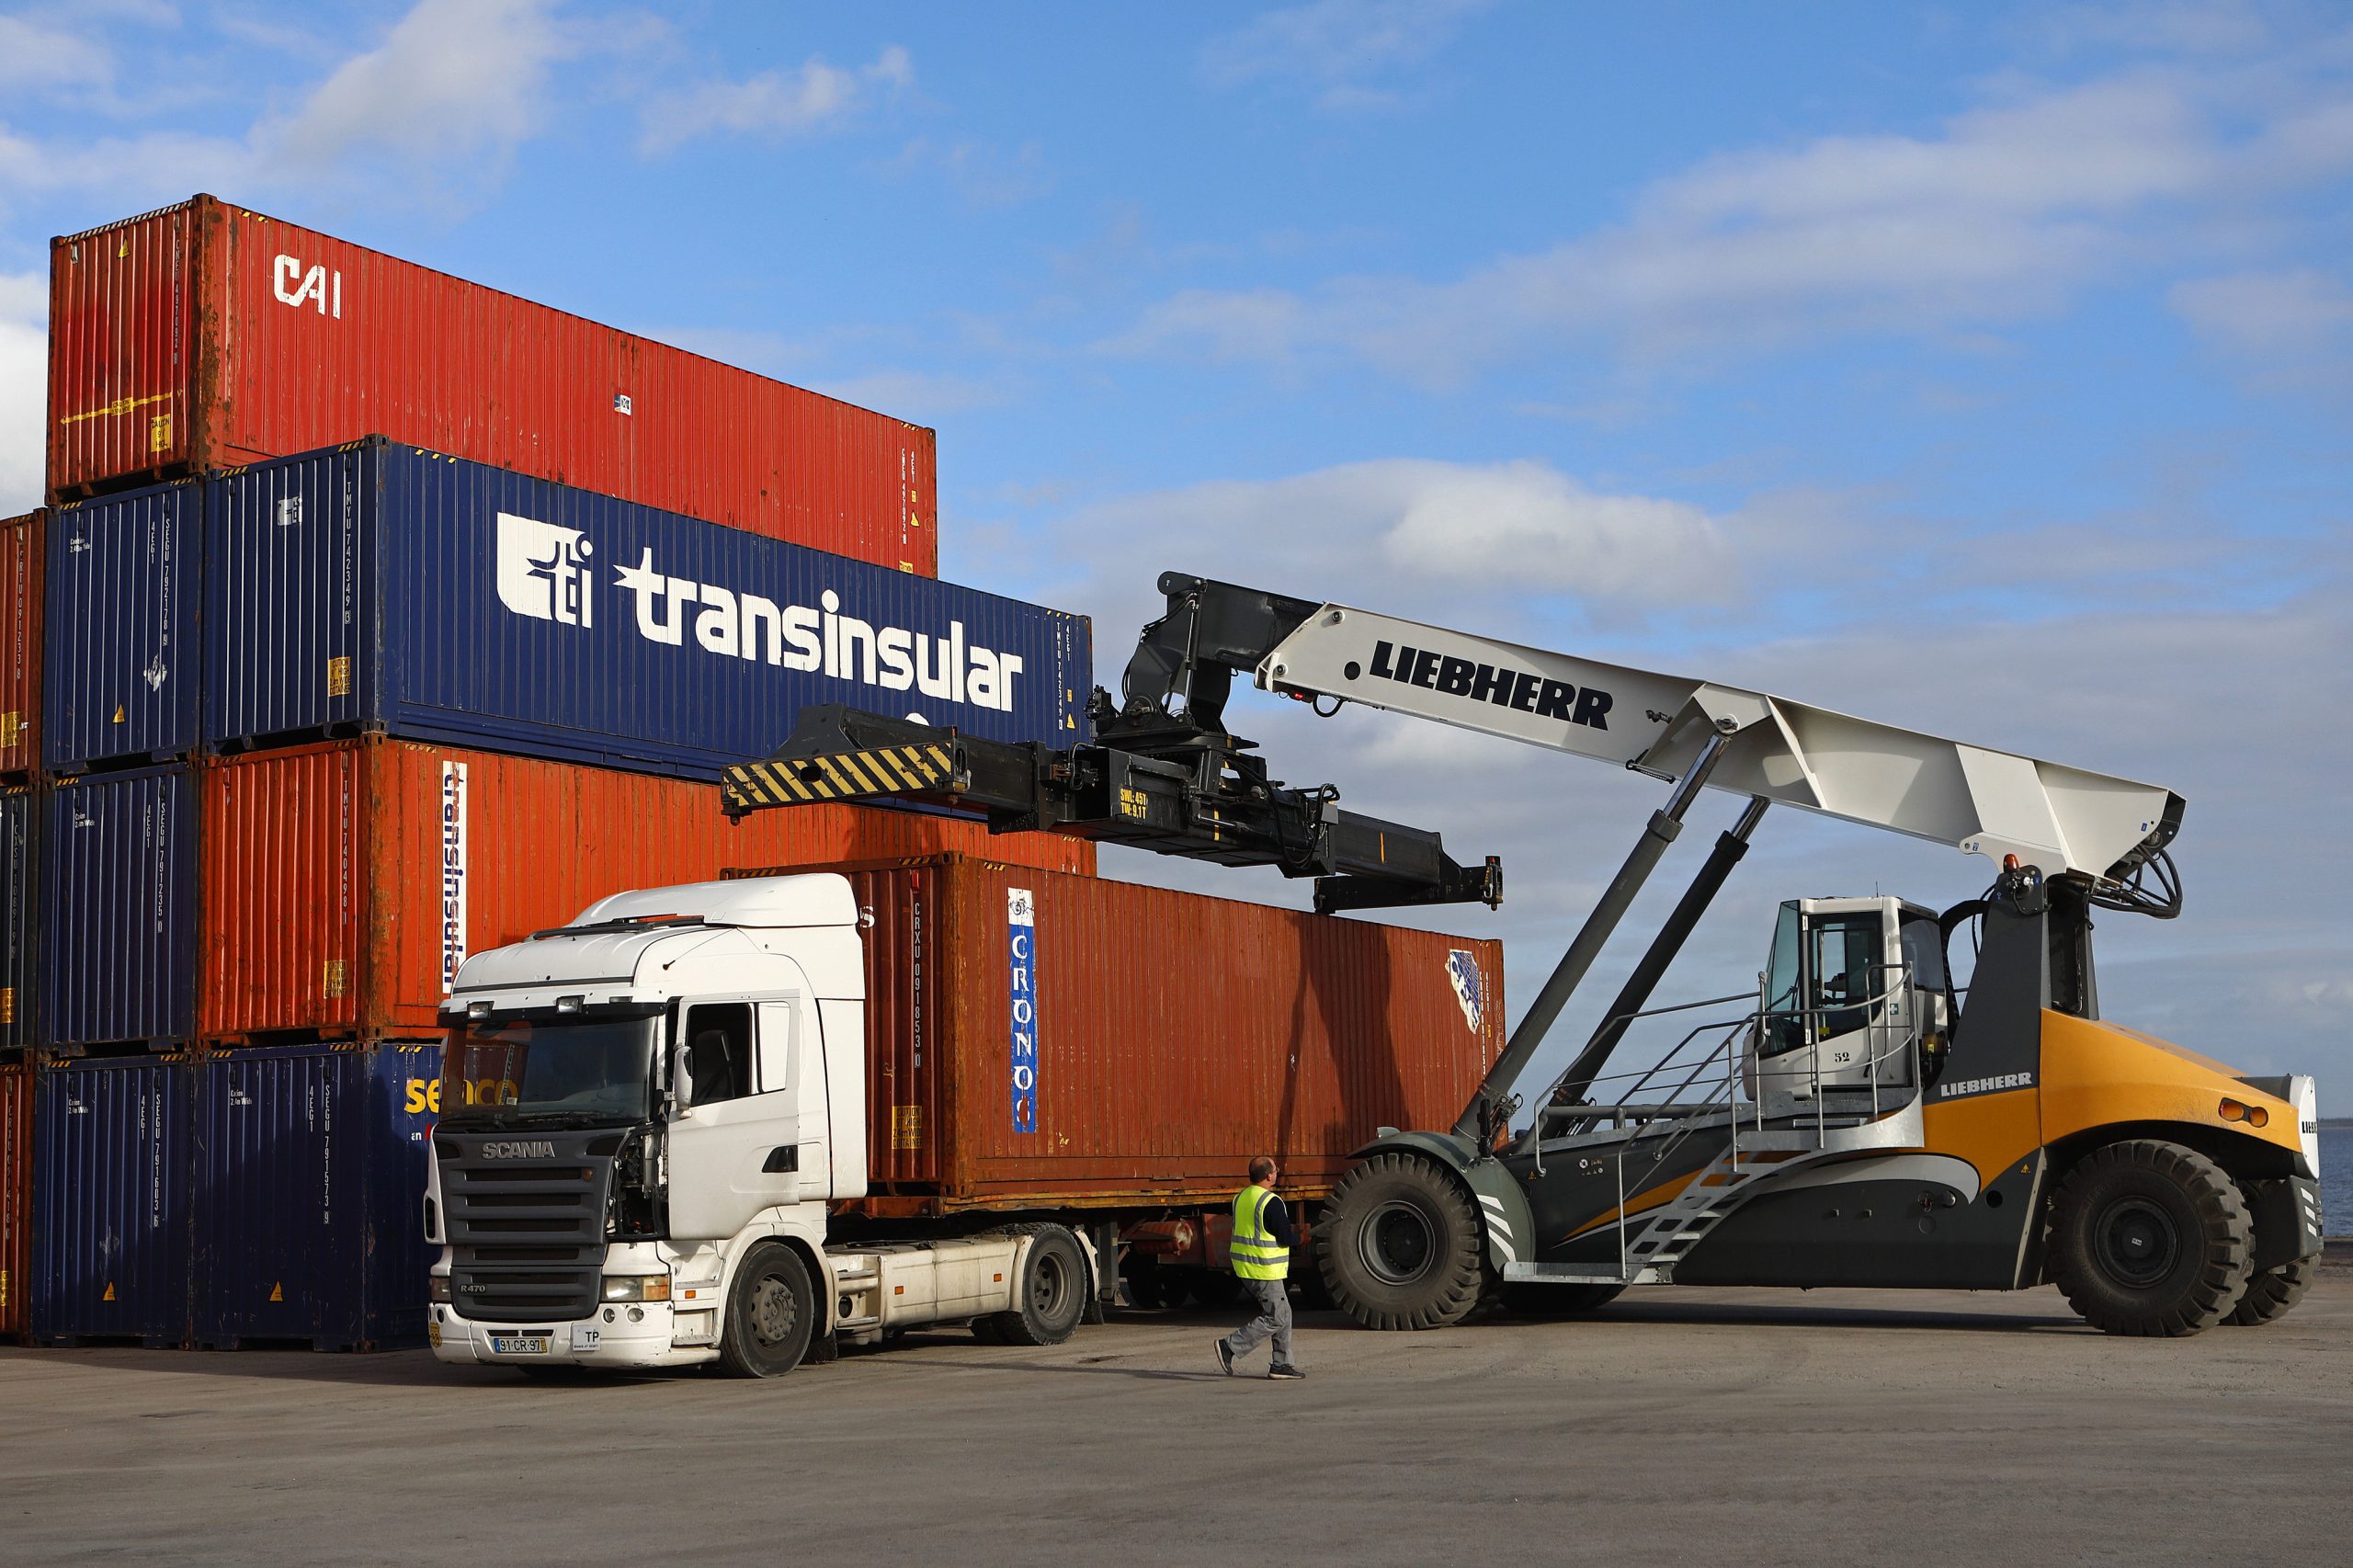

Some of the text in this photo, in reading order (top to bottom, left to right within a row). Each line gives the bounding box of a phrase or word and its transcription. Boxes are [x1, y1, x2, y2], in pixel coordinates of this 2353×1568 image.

[273, 254, 341, 320] CAI
[345, 610, 351, 624] 3
[613, 546, 1022, 713] transinsular
[1369, 640, 1613, 731] LIEBHERR
[1835, 1051, 1849, 1062] 52
[1940, 1072, 2032, 1096] LIEBHERR
[483, 1141, 556, 1159] SCANIA
[460, 1285, 486, 1293] R470
[585, 1331, 599, 1342] TP
